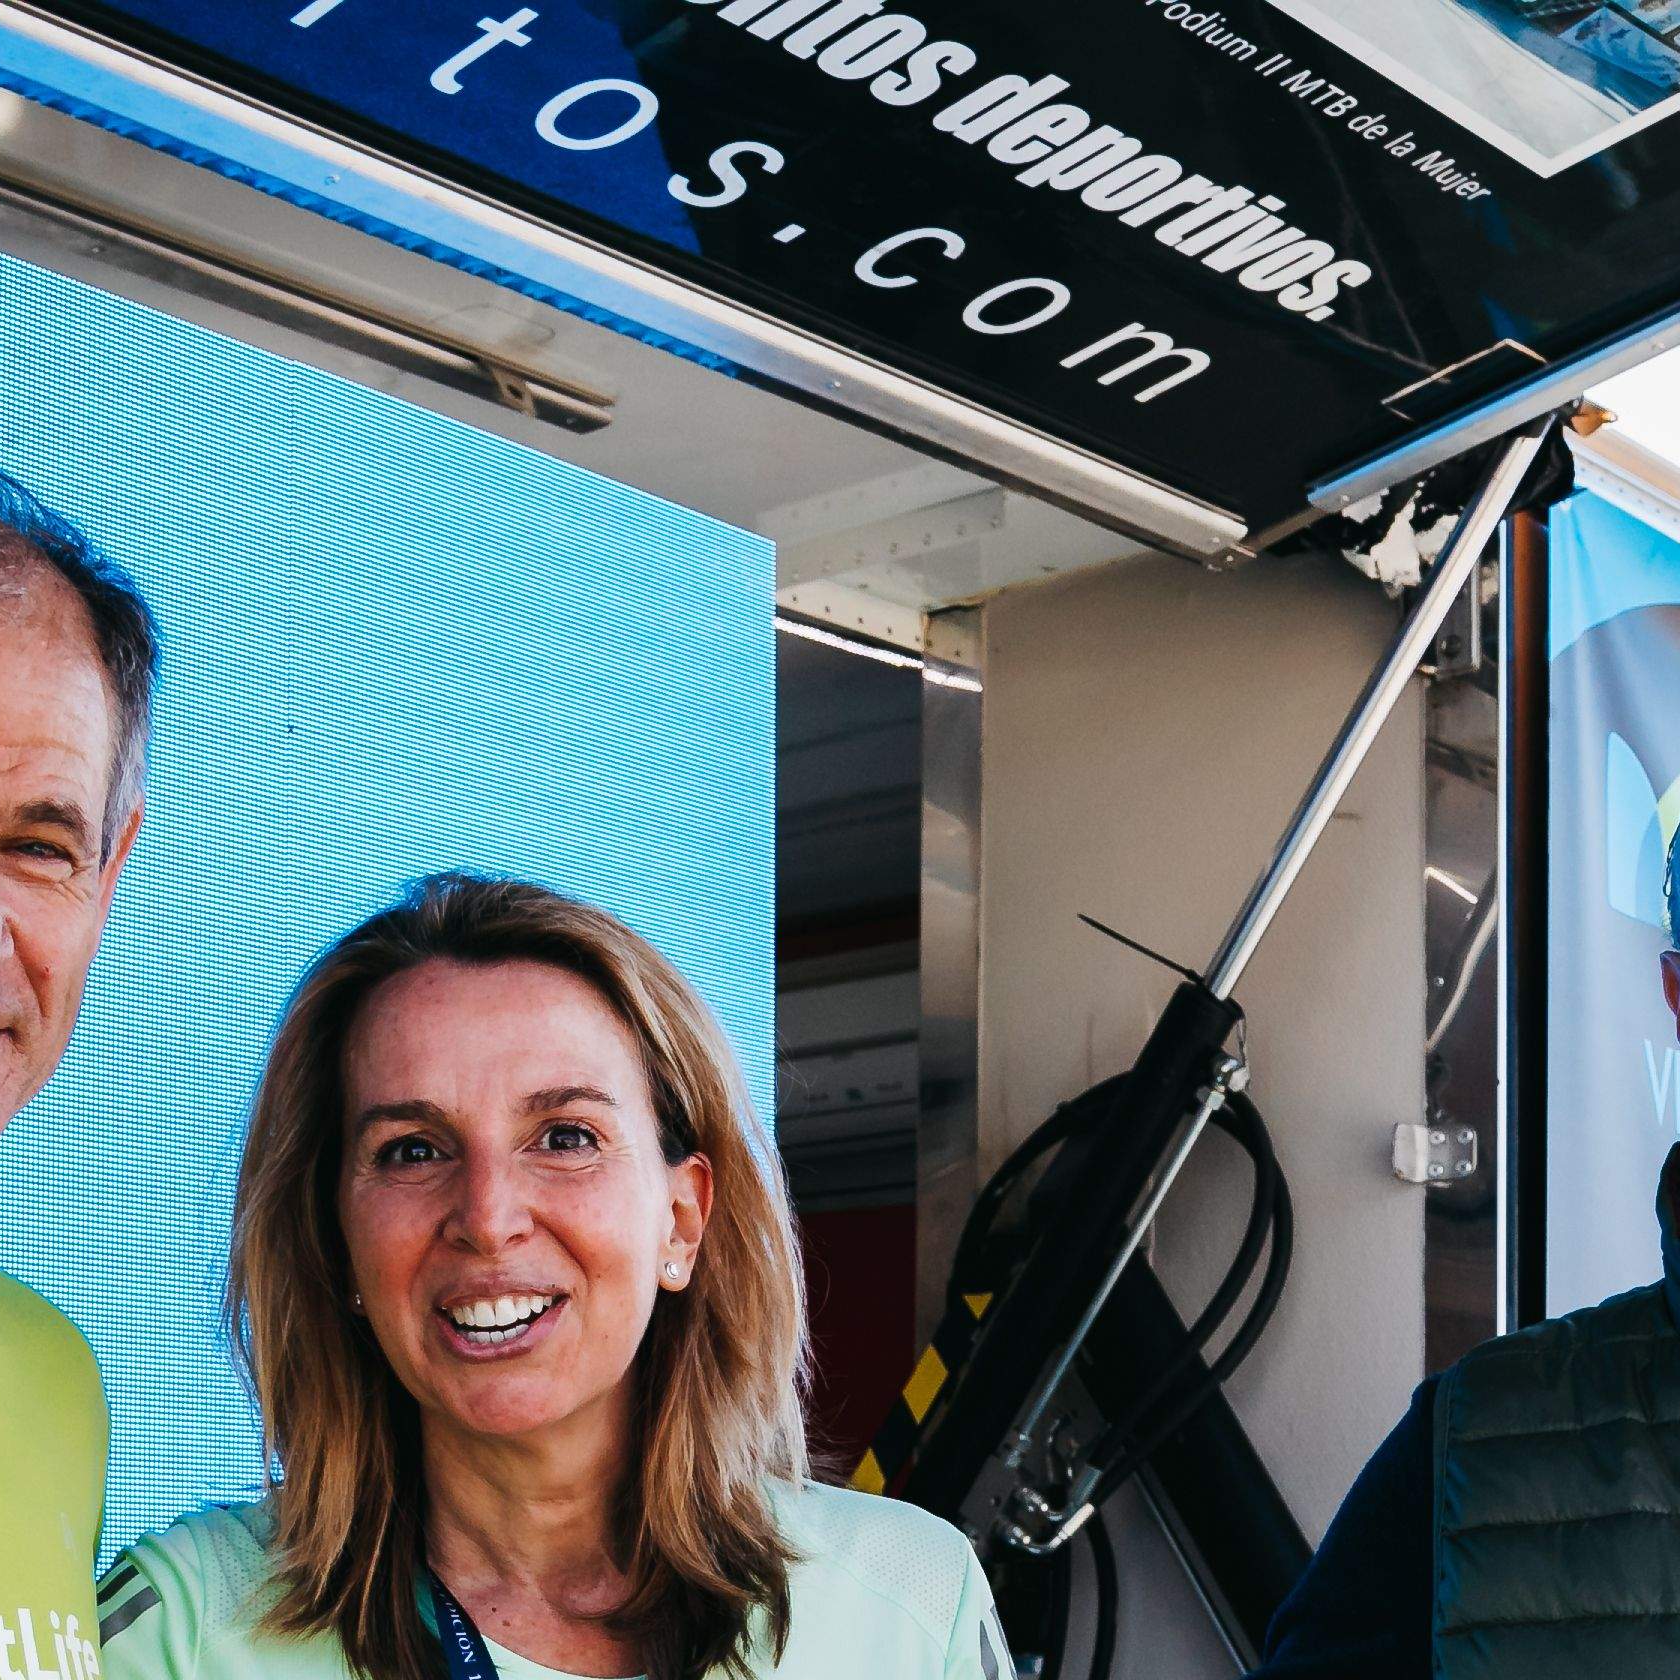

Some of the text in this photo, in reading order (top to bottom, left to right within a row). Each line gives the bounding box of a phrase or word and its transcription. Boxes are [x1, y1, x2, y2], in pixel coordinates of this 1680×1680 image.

[932, 73, 1372, 321] deportivos.
[1255, 53, 1292, 76] II
[1280, 70, 1358, 117] MTB
[1347, 114, 1389, 140] de
[1383, 131, 1416, 157] la
[1411, 150, 1491, 200] Mujer
